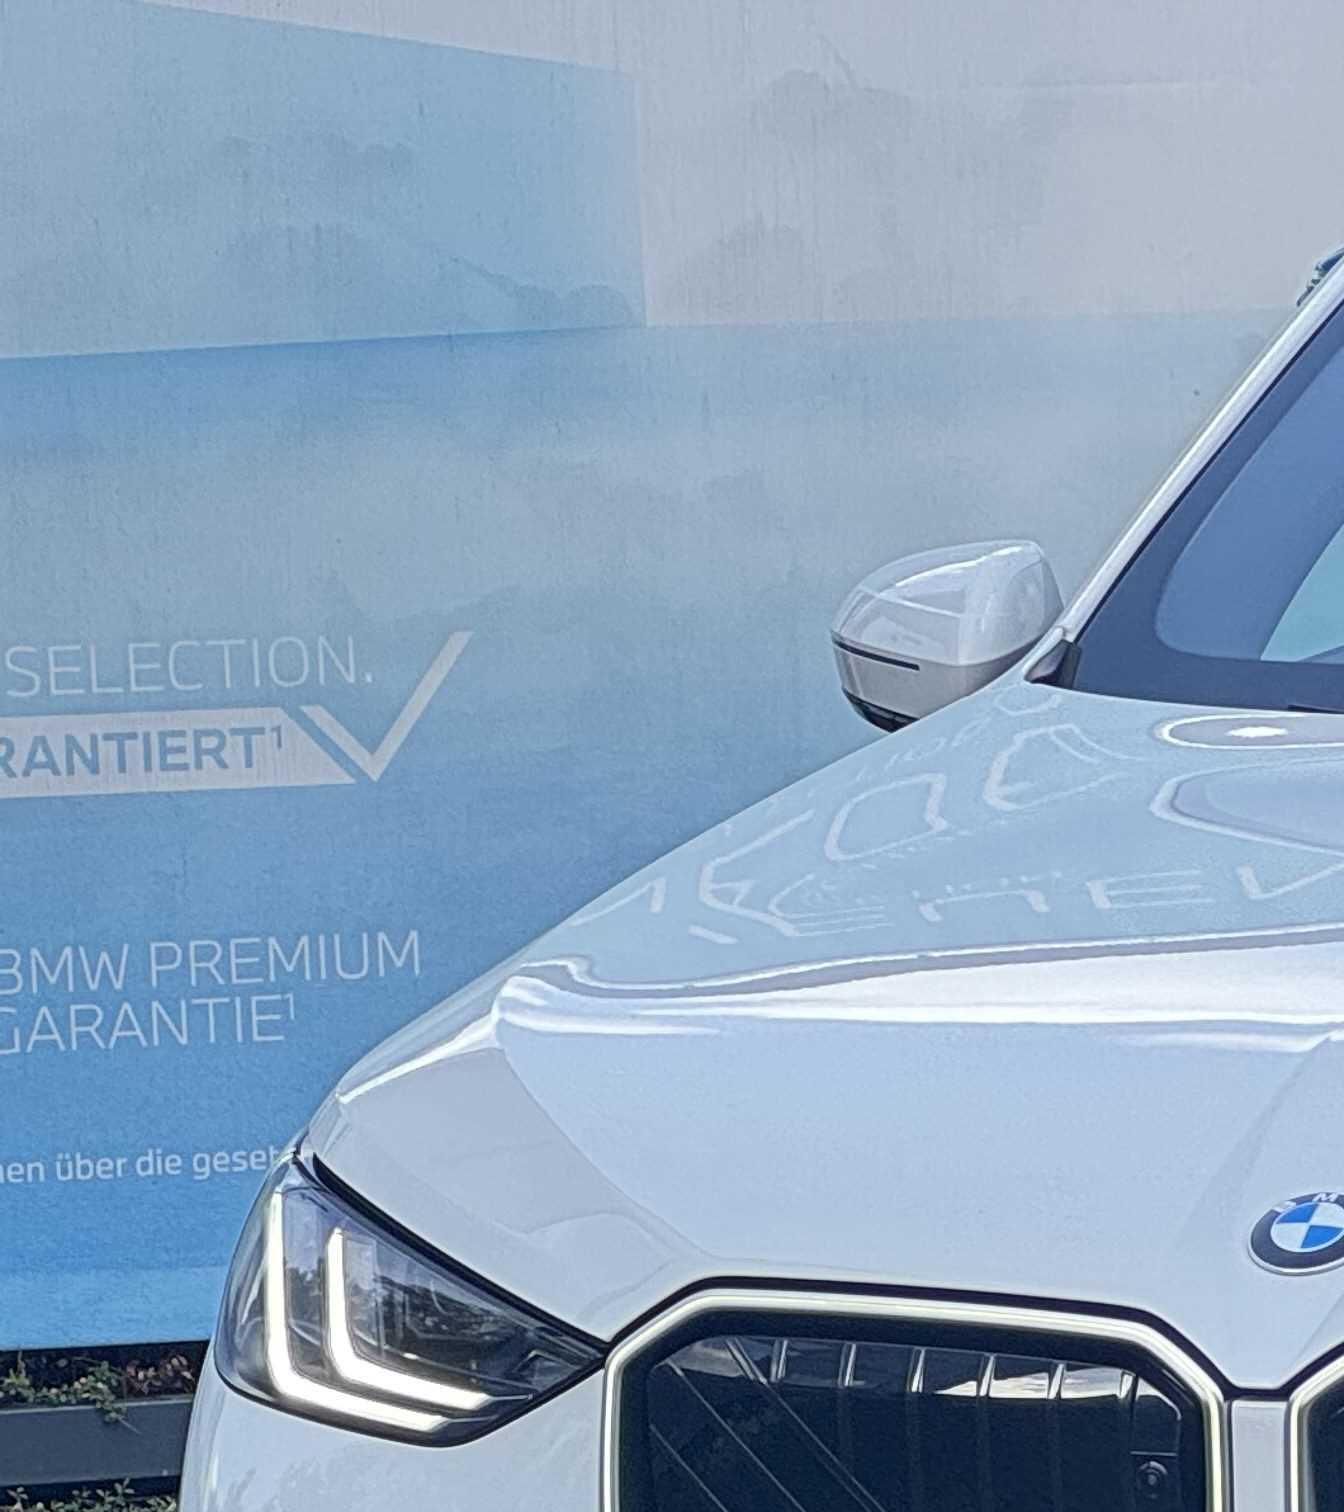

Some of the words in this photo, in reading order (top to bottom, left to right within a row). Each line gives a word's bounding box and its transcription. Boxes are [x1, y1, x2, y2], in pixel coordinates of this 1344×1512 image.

[4, 635, 373, 697] SELECTION.
[0, 942, 130, 996] BMW
[149, 928, 421, 987] PREMIUM
[0, 1157, 45, 1183] en
[55, 1151, 127, 1182] über
[135, 1147, 182, 1177] die
